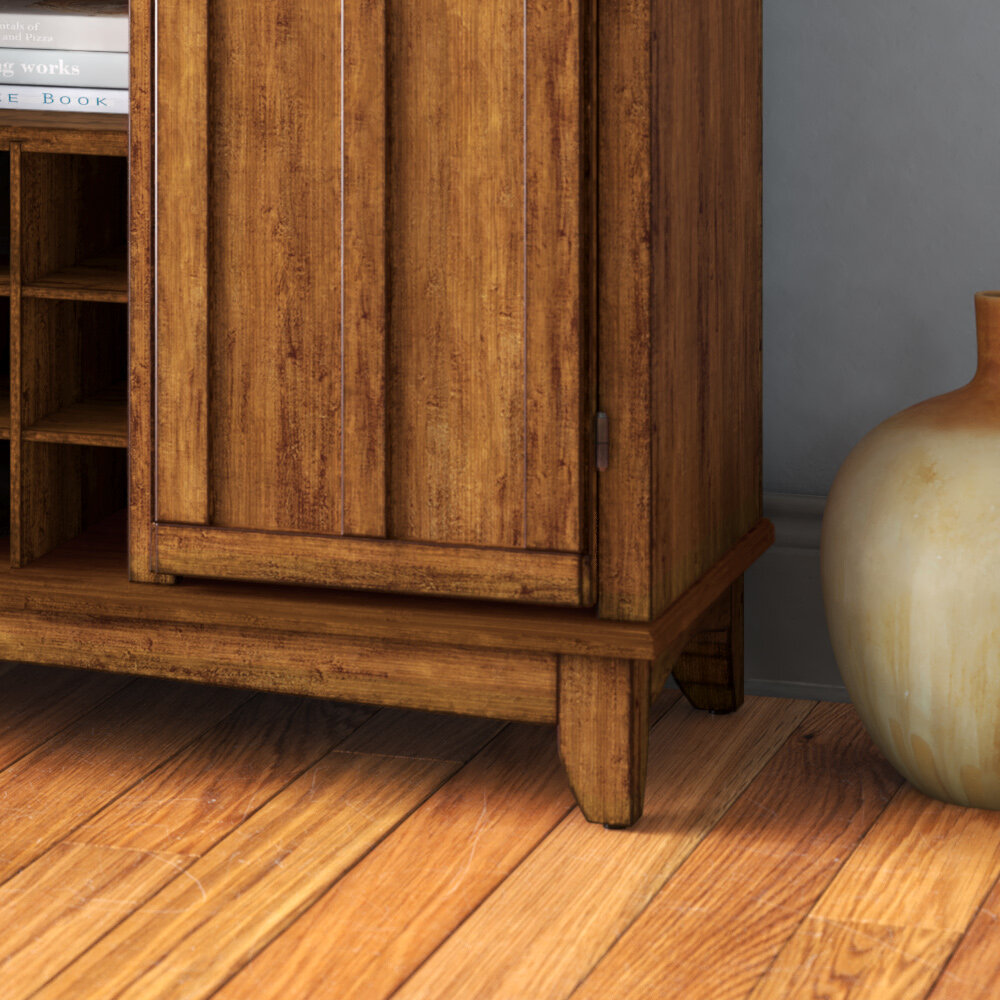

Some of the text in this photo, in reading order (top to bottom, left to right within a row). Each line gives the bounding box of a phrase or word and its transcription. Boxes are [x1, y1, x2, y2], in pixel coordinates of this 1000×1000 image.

[27, 23, 40, 32] of
[2, 32, 22, 42] and
[26, 33, 54, 42] Pizza
[20, 59, 80, 76] works
[42, 92, 108, 106] BOOK
